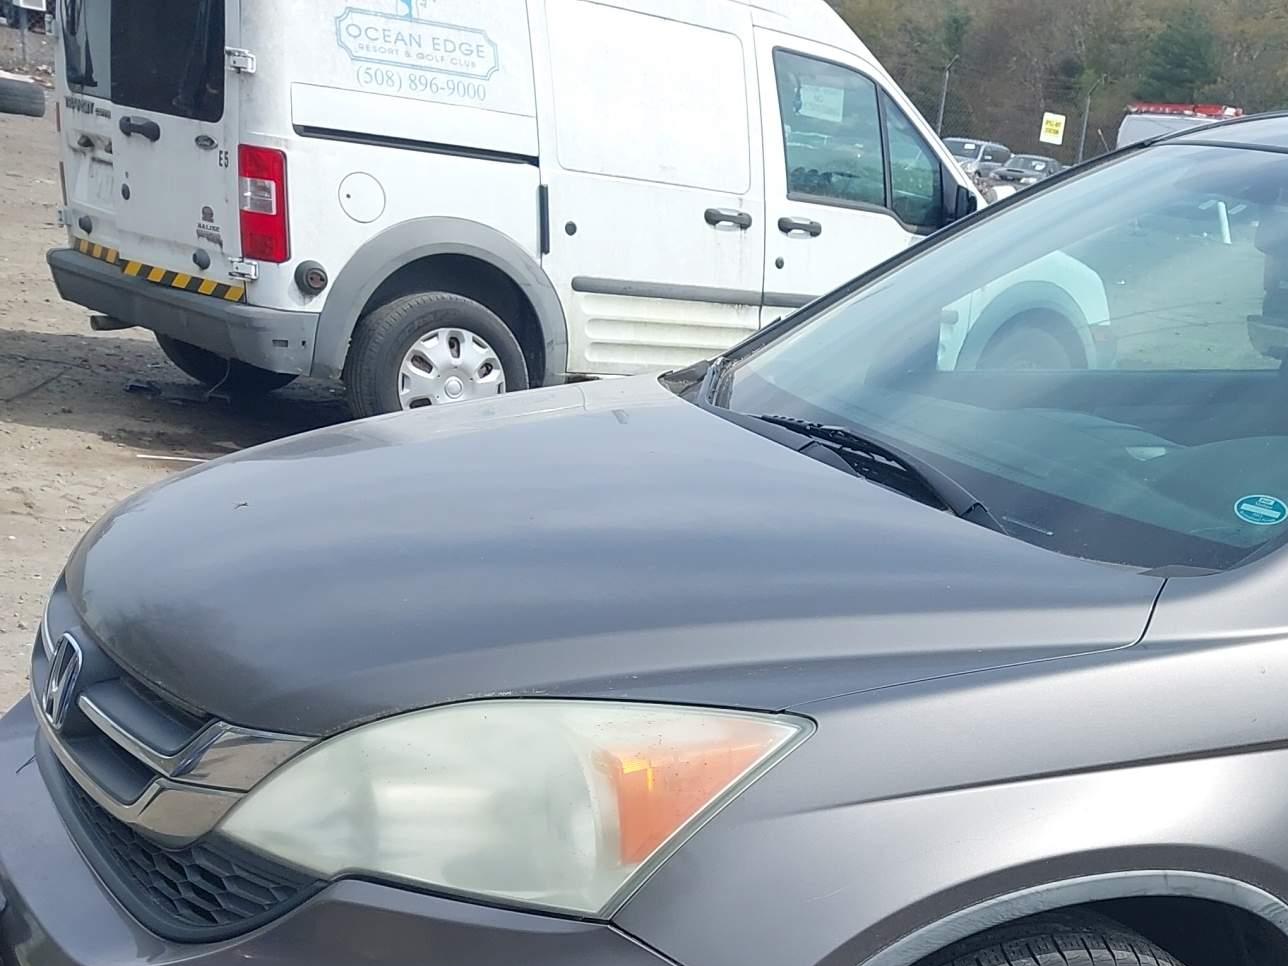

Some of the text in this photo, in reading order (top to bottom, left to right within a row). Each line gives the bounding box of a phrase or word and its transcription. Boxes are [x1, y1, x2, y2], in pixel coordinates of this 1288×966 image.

[346, 23, 486, 59] OCEAN EDGE
[358, 43, 476, 68] RESORT & GOLF CLUB
[356, 65, 487, 101] (508) 896-9000
